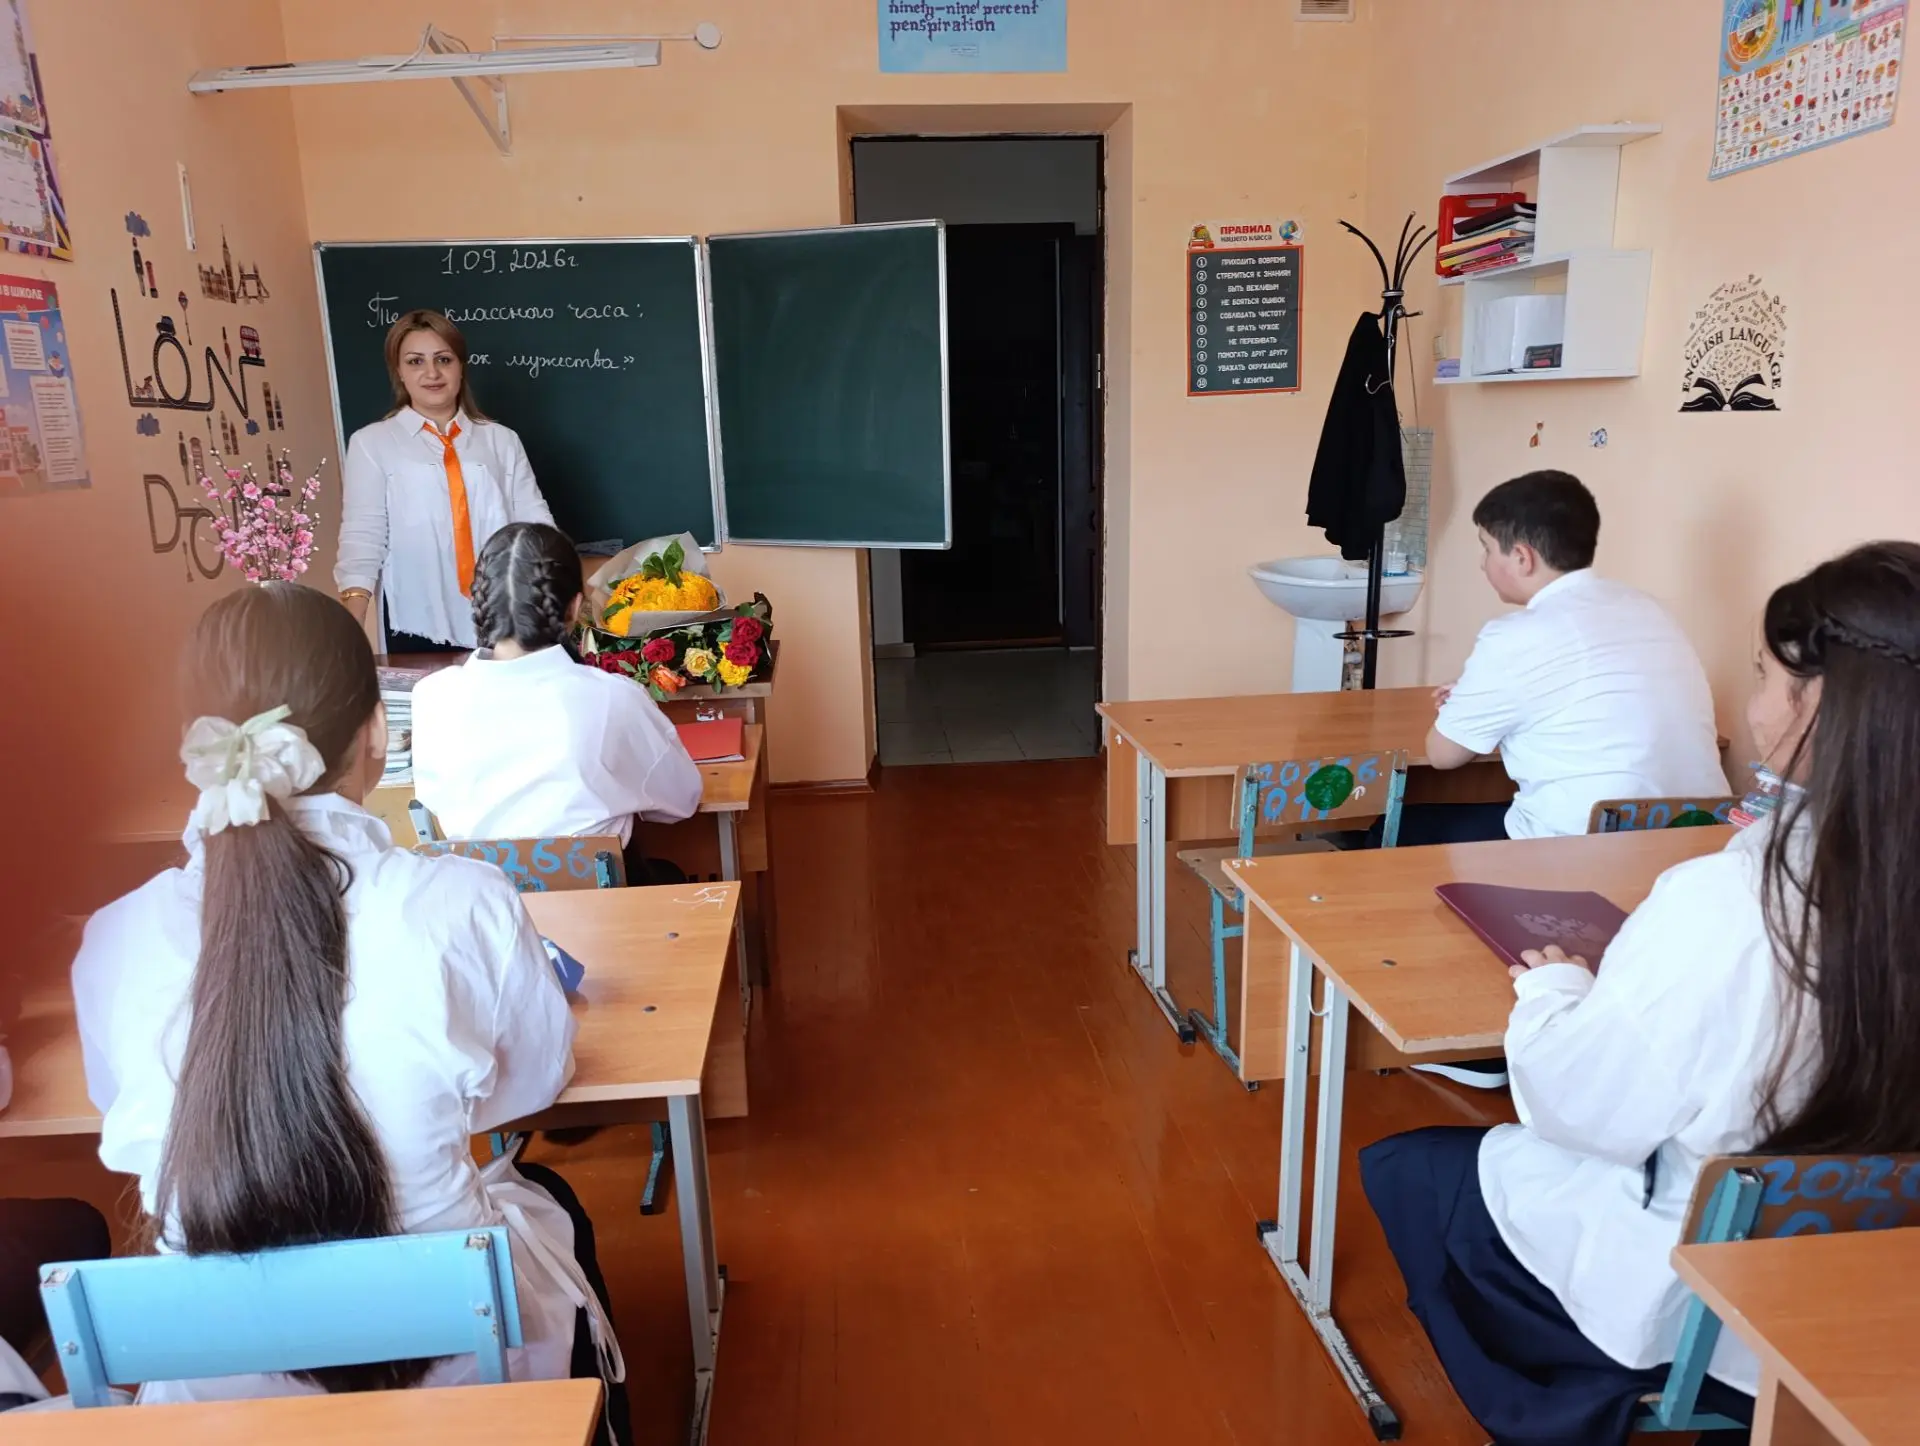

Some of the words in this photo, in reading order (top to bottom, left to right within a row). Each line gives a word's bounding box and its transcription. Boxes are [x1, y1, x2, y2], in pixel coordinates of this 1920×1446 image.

[1220, 225, 1272, 234] ПРАВИЛА
[367, 292, 398, 327] Те
[445, 307, 554, 321] классного
[1682, 330, 1724, 392] ENGLISH
[1729, 327, 1782, 389] LANGUAGE
